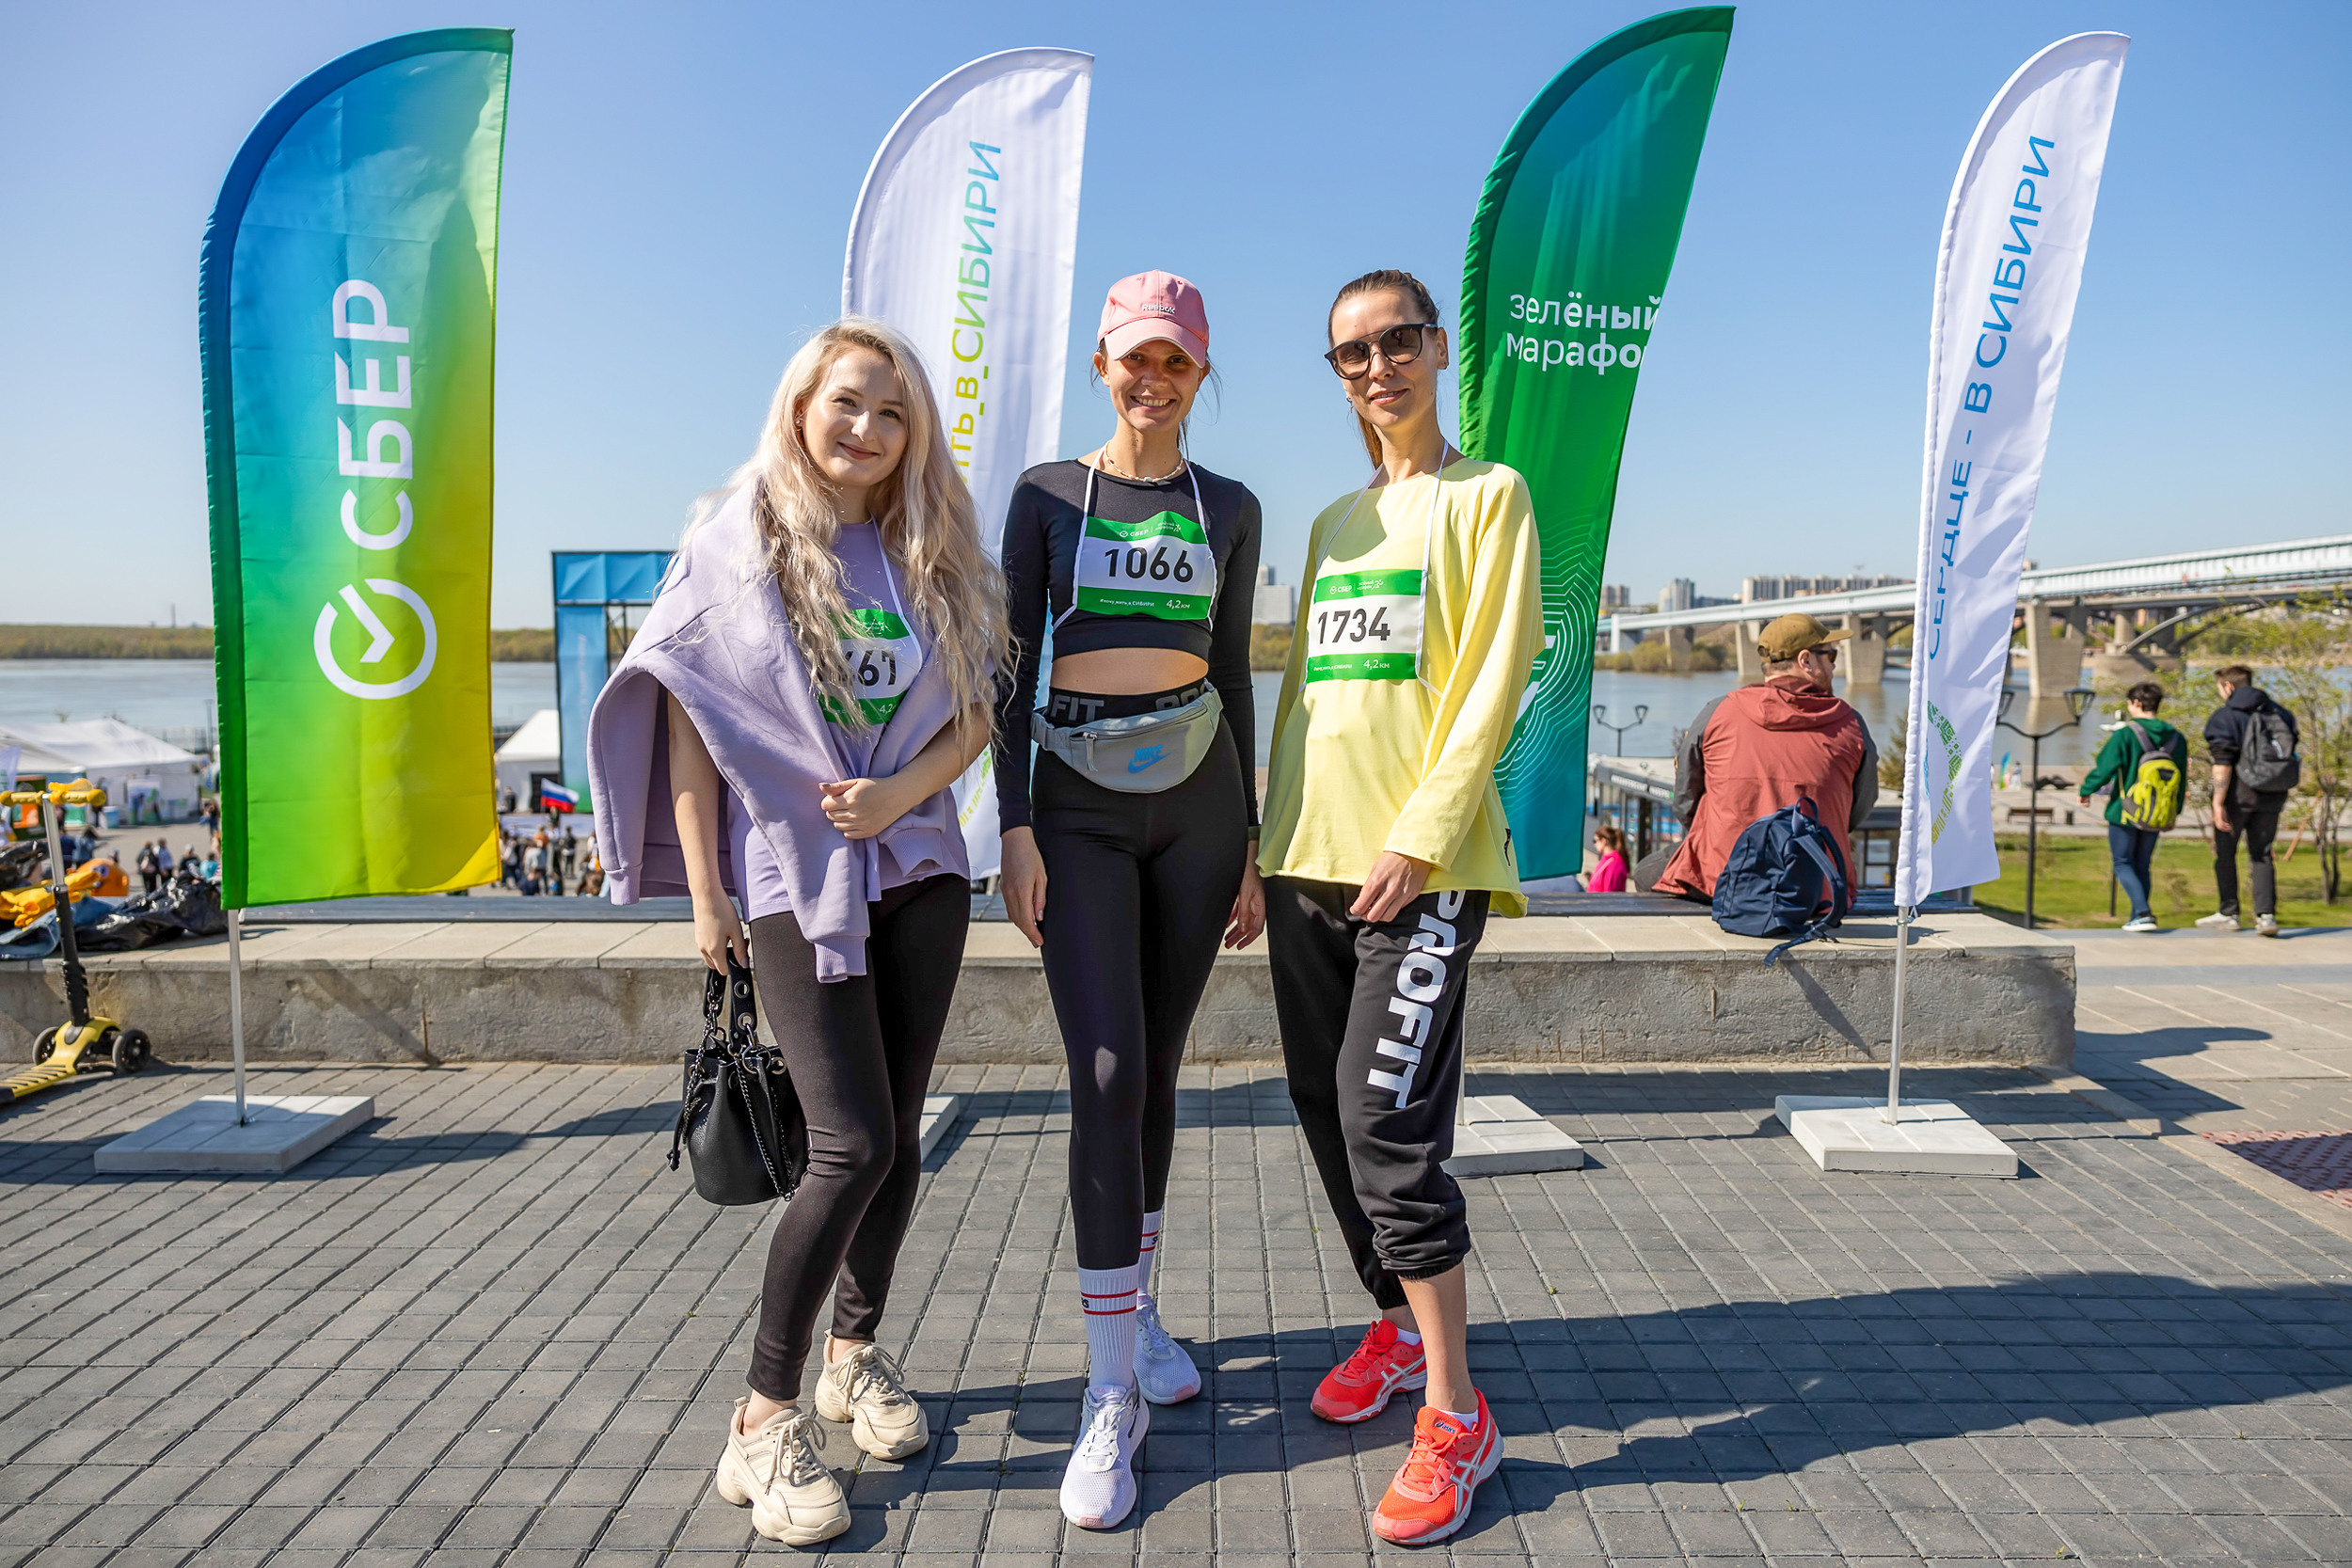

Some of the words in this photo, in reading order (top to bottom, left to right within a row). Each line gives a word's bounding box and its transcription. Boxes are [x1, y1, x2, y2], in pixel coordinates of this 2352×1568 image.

[1976, 135, 2055, 369] СИБИРИ
[1509, 291, 1662, 331] зелёный
[1506, 332, 1647, 375] марафо
[332, 279, 414, 551] СБЕР
[1104, 546, 1193, 583] 1066
[1317, 607, 1391, 645] 1734
[1048, 694, 1105, 723] FIT
[1134, 744, 1164, 763] NIKE
